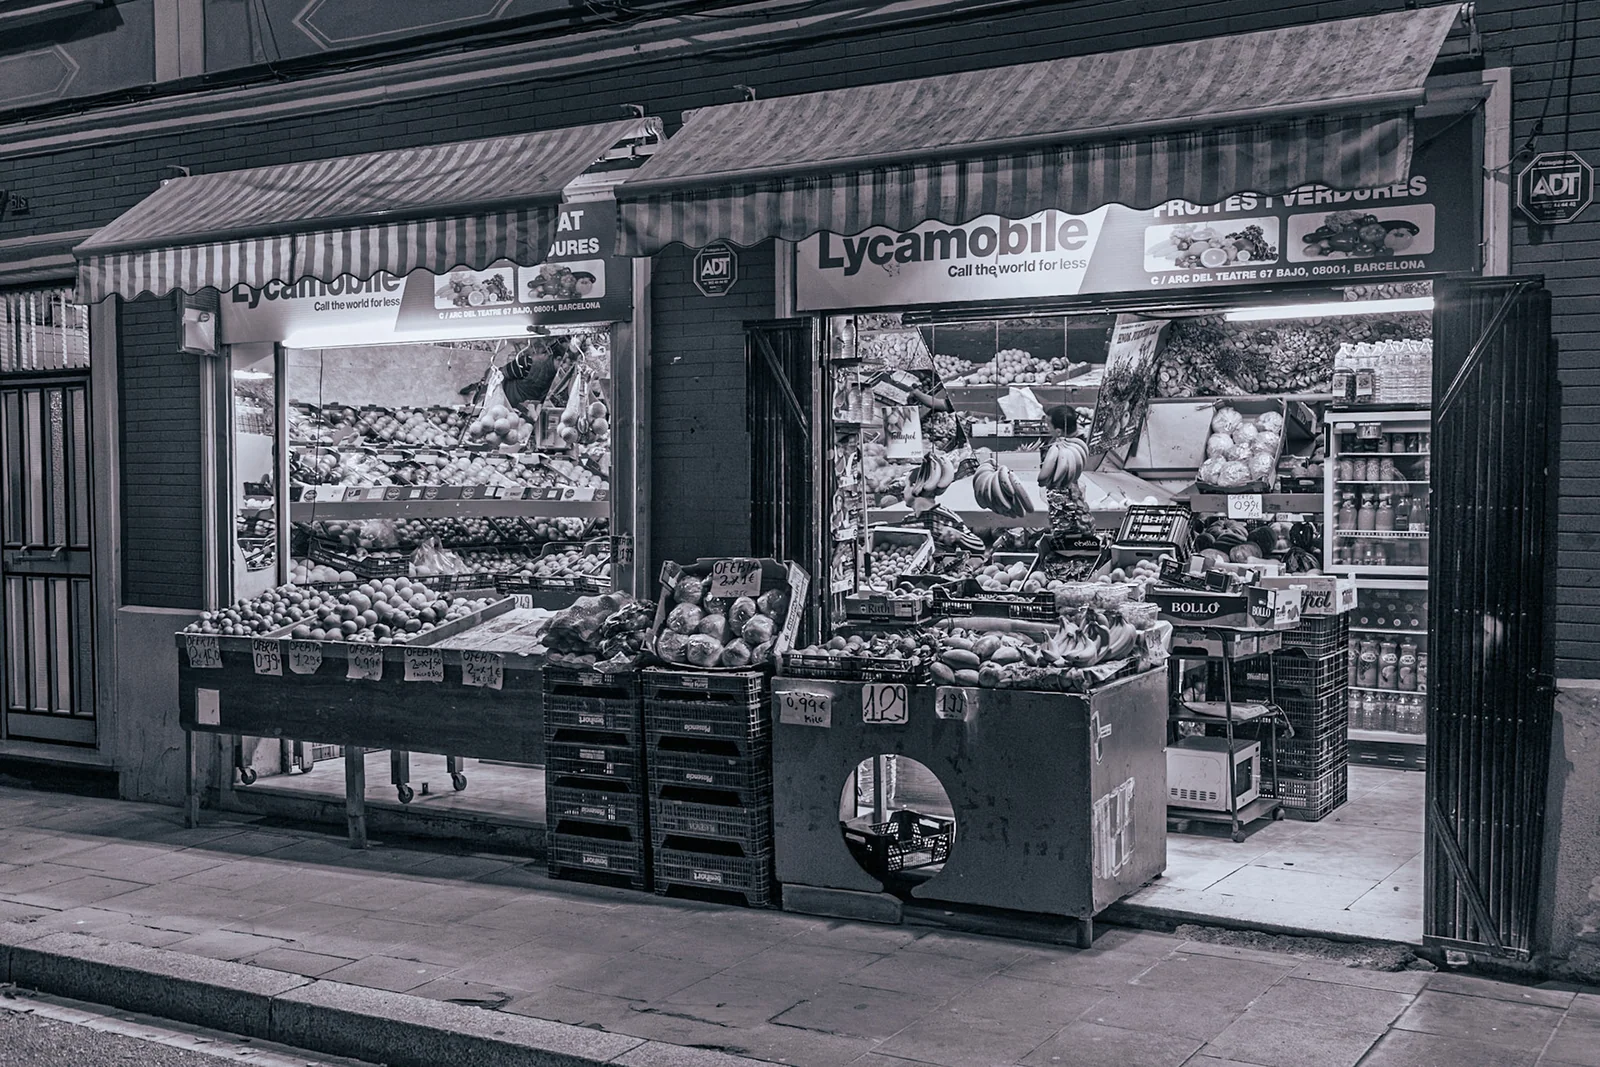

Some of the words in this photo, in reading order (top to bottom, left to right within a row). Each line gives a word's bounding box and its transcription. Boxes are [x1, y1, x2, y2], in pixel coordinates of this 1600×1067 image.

[1531, 172, 1580, 197] ADT
[557, 210, 584, 232] AT
[818, 209, 1089, 277] Lycamobile
[701, 258, 730, 276] ADT
[947, 264, 973, 278] Call
[975, 263, 997, 276] the
[999, 260, 1035, 275] world
[1038, 259, 1058, 272] for
[1059, 257, 1087, 270] less
[1150, 276, 1159, 285] C
[1168, 275, 1190, 285] ARC
[1192, 273, 1212, 283] DEL
[1216, 270, 1256, 282] TEATRE
[1259, 269, 1273, 279] 67
[1276, 267, 1309, 278] BAJO,
[1312, 264, 1350, 276] 08001,
[1354, 260, 1426, 272] BARCELONA
[314, 301, 330, 311] Call
[331, 300, 345, 310] the
[346, 298, 369, 309] world
[370, 298, 382, 308] for
[383, 296, 400, 306] less
[477, 309, 502, 317] TEATRE
[558, 302, 600, 311] BARCELONA
[714, 561, 760, 575] OFERTA
[1171, 602, 1218, 614] BOLLO
[1252, 605, 1271, 618] BOLLO
[406, 648, 440, 657] OFERTA
[786, 697, 826, 713] 0.99€
